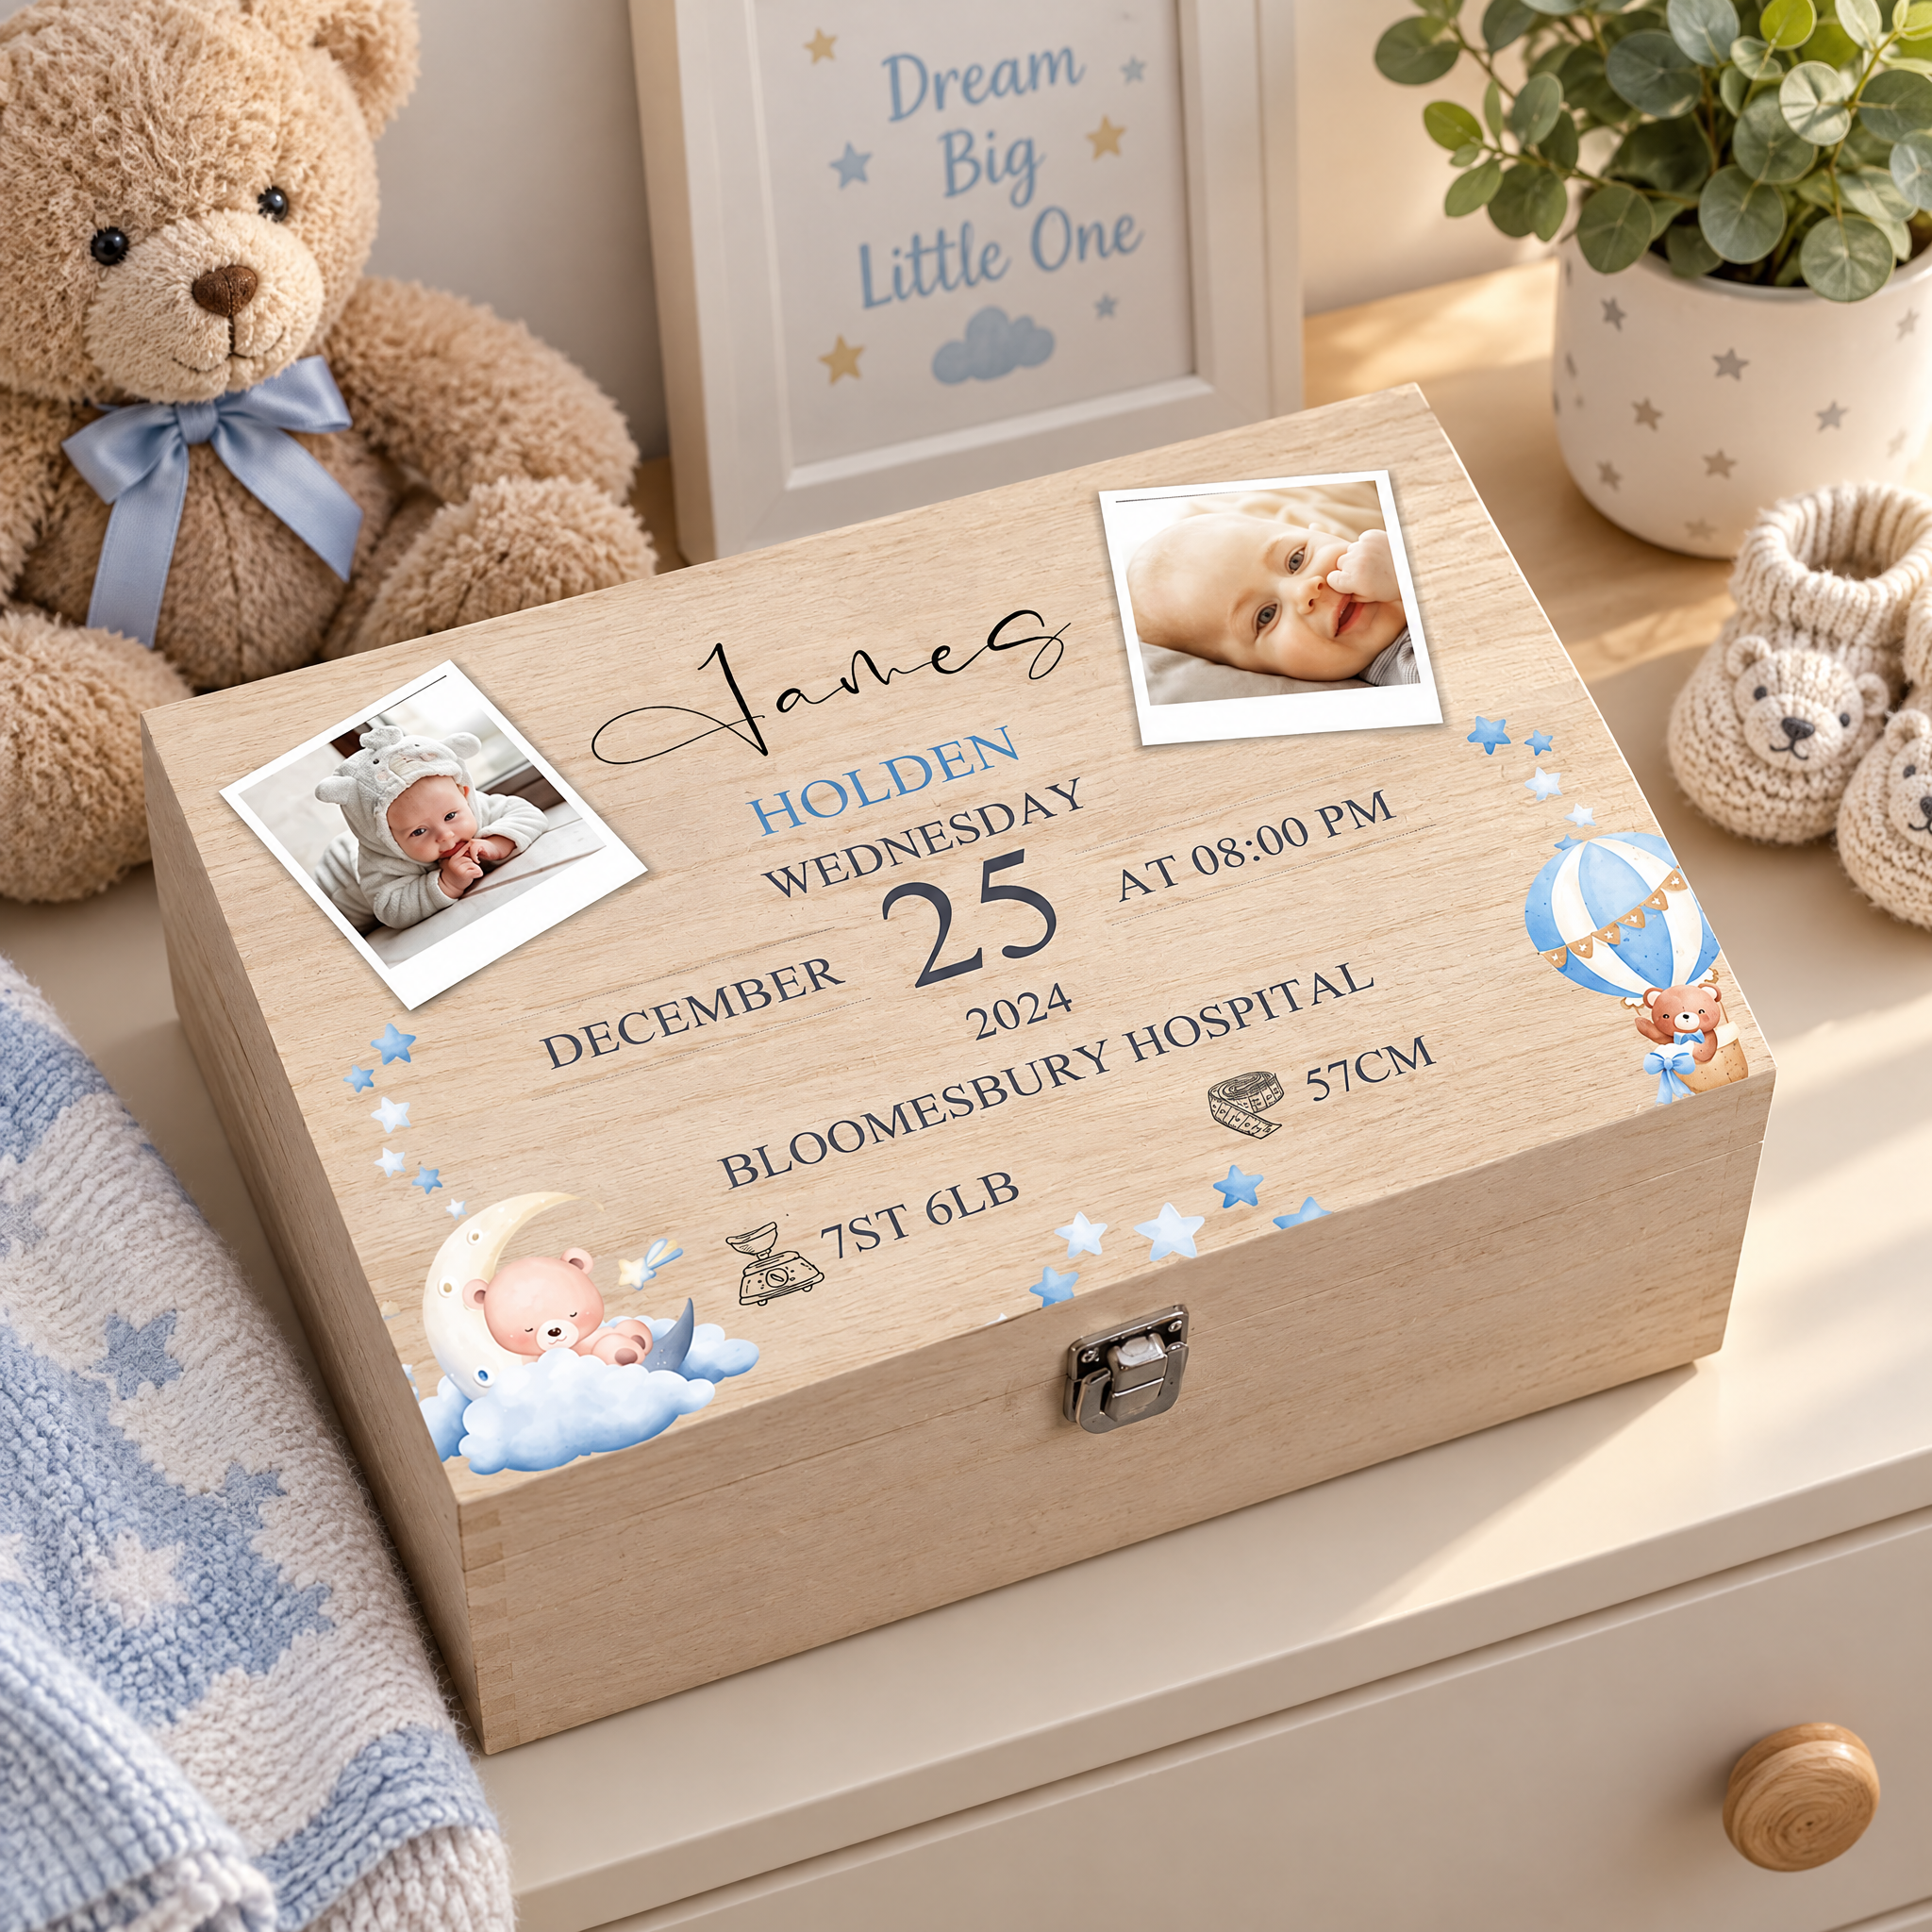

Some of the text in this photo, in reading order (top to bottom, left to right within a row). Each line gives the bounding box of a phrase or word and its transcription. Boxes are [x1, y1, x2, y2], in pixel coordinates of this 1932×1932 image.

[881, 46, 1086, 123] Dream
[938, 128, 1046, 208] Big
[858, 206, 1143, 309] Little One
[591, 609, 1072, 765] James
[745, 724, 1020, 838] HOLDEN
[761, 776, 1084, 899] WEDNESDAY
[540, 789, 1397, 1071] DECEMBER 25 AT 08:00 PM
[965, 982, 1074, 1041] 2024
[717, 1040, 1110, 1191] BLOOMESBURY
[1122, 962, 1375, 1063] HOSPITAL
[1306, 1035, 1437, 1103] 57CM
[820, 1171, 1020, 1259] 7ST 6LB
